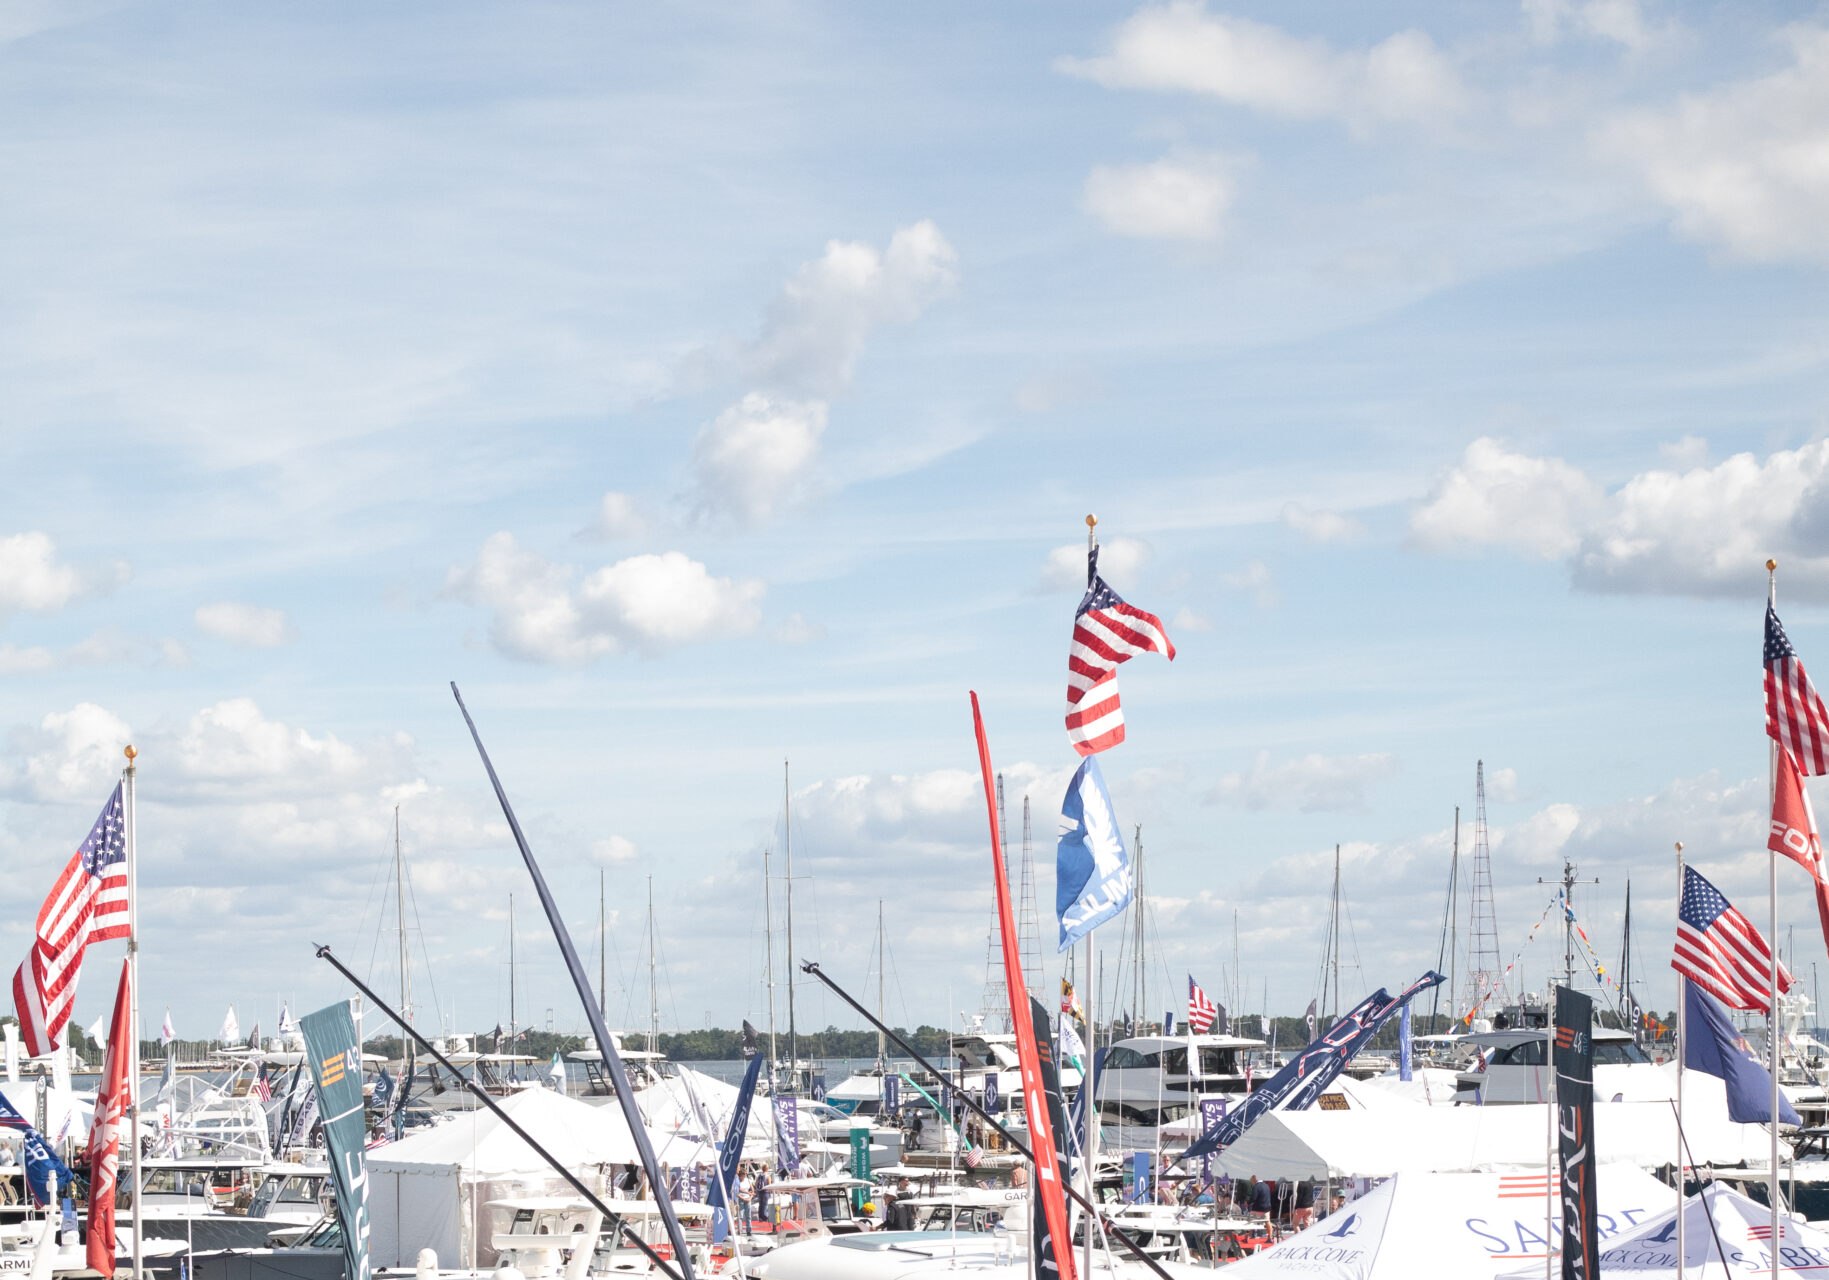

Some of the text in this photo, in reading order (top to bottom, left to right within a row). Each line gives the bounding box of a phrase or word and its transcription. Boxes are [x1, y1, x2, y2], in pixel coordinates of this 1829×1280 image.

[722, 1105, 748, 1172] COBI
[1268, 1247, 1364, 1264] BACK COVE
